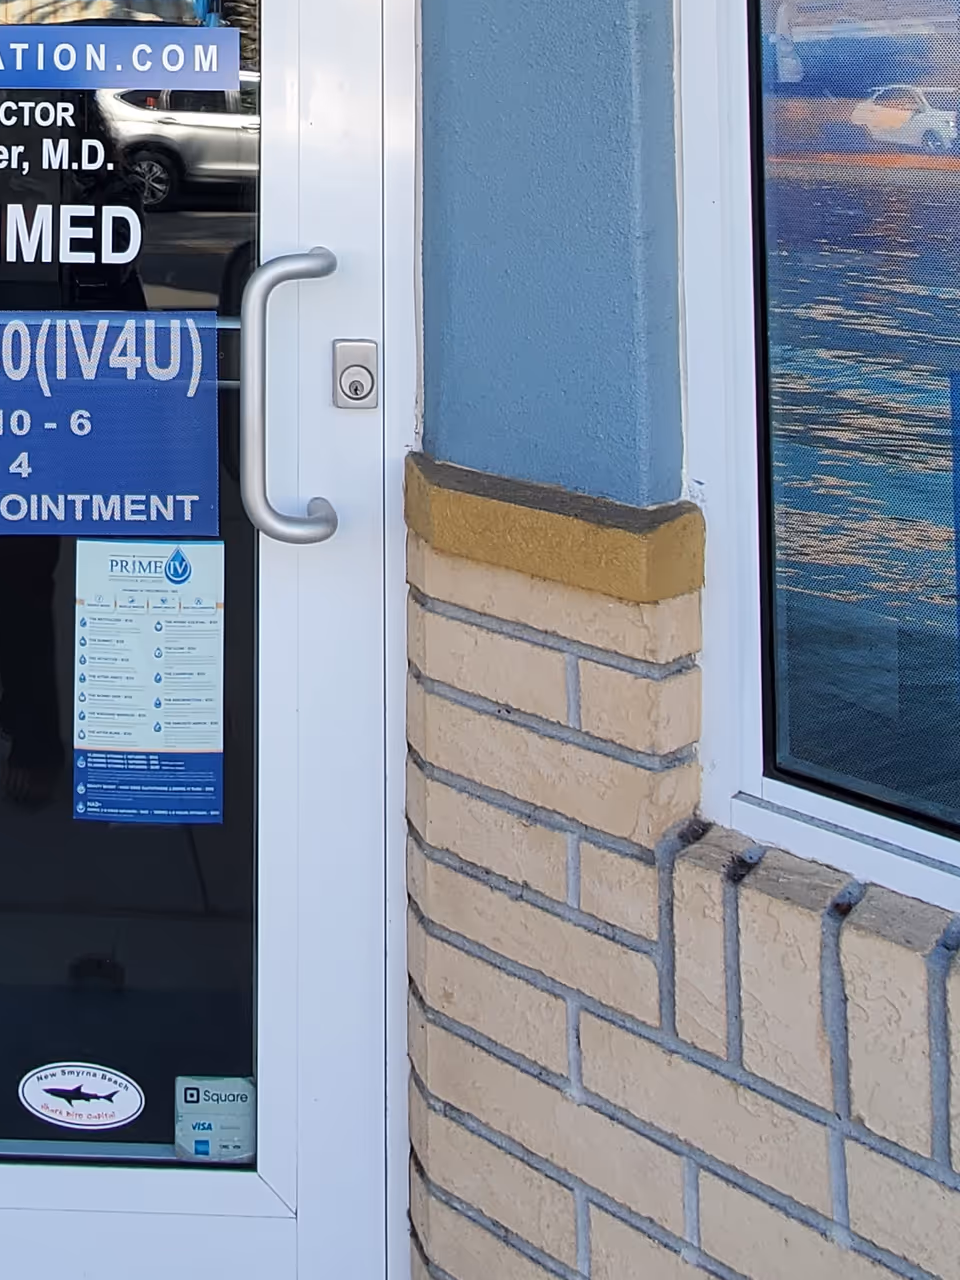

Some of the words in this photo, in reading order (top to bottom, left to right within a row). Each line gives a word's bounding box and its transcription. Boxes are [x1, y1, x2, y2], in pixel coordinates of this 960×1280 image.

[41, 138, 115, 171] M.D.
[69, 409, 93, 437] 6
[8, 451, 33, 478] 4
[170, 561, 187, 575] IV
[36, 1072, 57, 1083] New
[61, 1069, 98, 1078] Smyrna
[101, 1073, 130, 1092] Beach
[203, 1089, 249, 1105] Square
[191, 1121, 214, 1131] VISA
